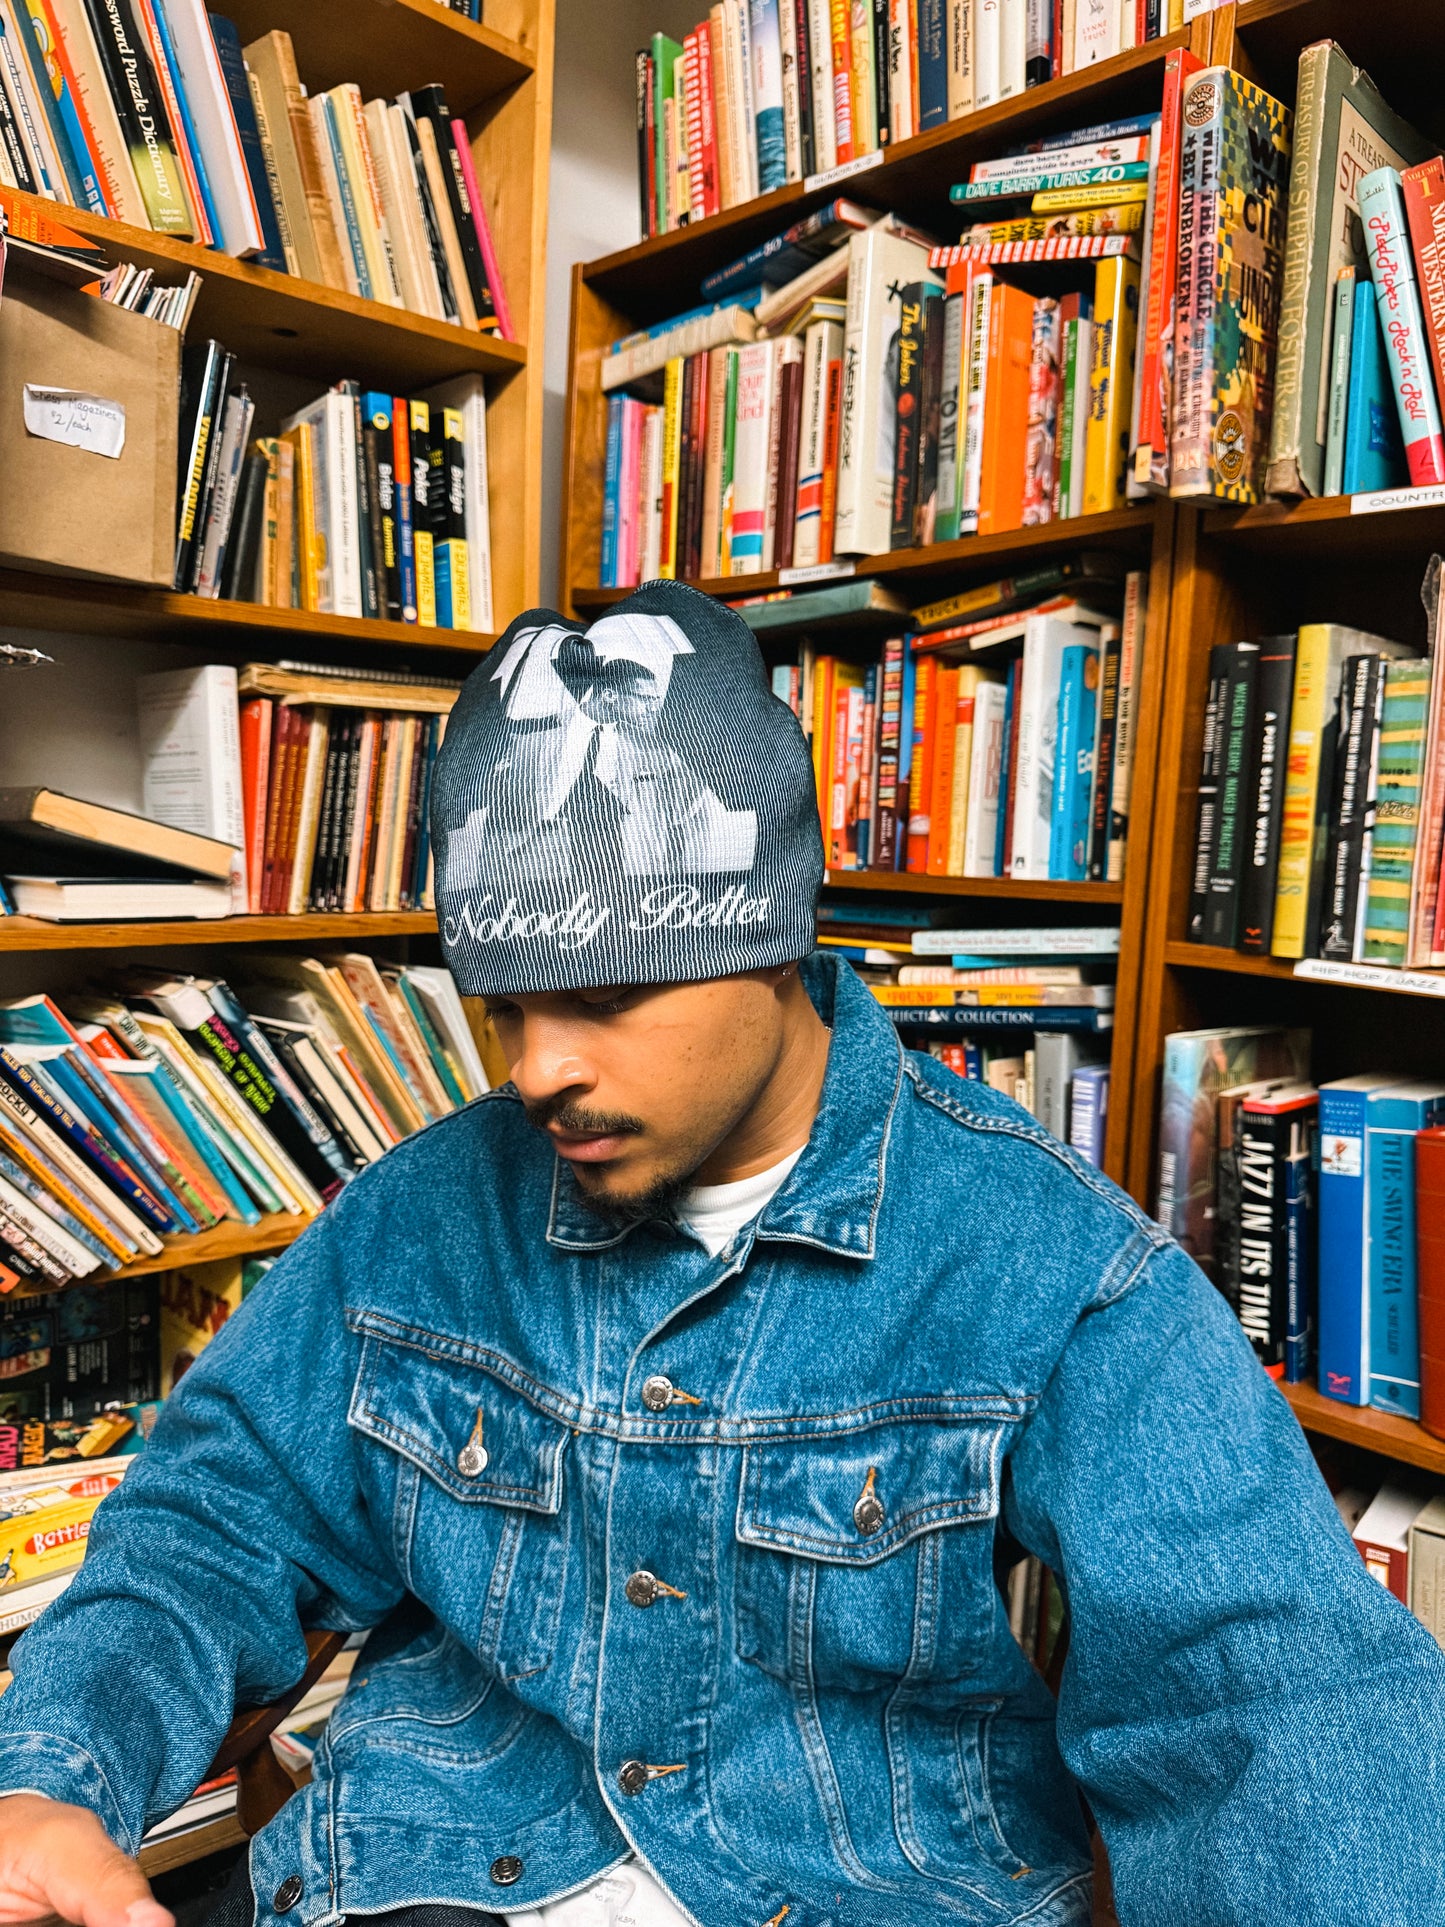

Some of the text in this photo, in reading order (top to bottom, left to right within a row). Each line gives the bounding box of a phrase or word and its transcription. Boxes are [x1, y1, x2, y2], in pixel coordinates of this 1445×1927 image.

[1082, 20, 1108, 34] LYNNE
[1084, 29, 1107, 43] TRUSS
[16, 88, 26, 105] NAME
[117, 54, 153, 114] Puzzle
[1295, 70, 1315, 156] TREASURY
[132, 111, 182, 202] Dictionary
[1012, 150, 1069, 166] dave barry's
[1349, 128, 1356, 145] A
[964, 164, 1127, 199] DAVE BARRY TURNS 40
[1029, 161, 1056, 173] guide
[1070, 157, 1093, 167] guys
[1293, 159, 1309, 184] OF
[1406, 164, 1440, 181] VOLUME
[1419, 178, 1434, 198] 1
[1177, 149, 1195, 310] BE UNBROKEN
[1195, 129, 1214, 320] WILL THE CIRCLE
[1282, 187, 1310, 300] STEPHEN
[1368, 217, 1395, 258] Pied
[1144, 152, 1170, 355] VINYL HAYRIDE
[1376, 256, 1400, 311] Pipers
[1420, 241, 1445, 329] WESTERN
[896, 302, 920, 386] The Joker
[1275, 304, 1301, 397] FOSTER
[969, 367, 980, 392] SHOW
[1399, 380, 1427, 422] Roll
[838, 343, 860, 470] HERBLOCK
[938, 385, 957, 463] TO WIT
[177, 414, 212, 542] VENTRILOQUISM
[413, 457, 430, 506] Poker
[447, 464, 465, 515] Bridge
[1370, 492, 1445, 506] COUNTR
[376, 461, 397, 568] Bridge dummies
[919, 597, 961, 622] TRUCK
[1229, 681, 1251, 729] WICKED
[1351, 658, 1369, 709] WESTSIDE
[877, 640, 902, 808] DANGEROUSLY FUNNY
[1347, 735, 1360, 754] MEN
[1348, 708, 1364, 736] YOUNG
[1343, 769, 1356, 783] HIP
[1345, 754, 1358, 770] AND
[1221, 776, 1240, 814] NAKED
[1252, 710, 1278, 867] A PURE SOLAR WORLD
[1342, 784, 1355, 800] HOP
[1387, 782, 1400, 790] TO
[1277, 729, 1316, 898] NEW ATLANTIS
[1215, 815, 1236, 871] PRACTICE
[1331, 839, 1349, 916] WILLIAM SHAW
[444, 884, 770, 950] Nobody Better
[1312, 966, 1338, 974] HIP
[1344, 970, 1382, 980] HOP
[1397, 978, 1440, 990] JAZZ
[955, 1010, 1034, 1024] COLLECTION
[231, 1067, 272, 1116] OF MAGIC
[59, 1111, 77, 1129] TELL
[1380, 1135, 1403, 1297] THE SWING ERA
[20, 1239, 66, 1281] DAVID HORSEY
[1238, 1132, 1273, 1347] JAZZ IN ITS TIME
[0, 1425, 19, 1470] MAD
[22, 1420, 46, 1466] MAGIC
[0, 1606, 46, 1632] HUMO
